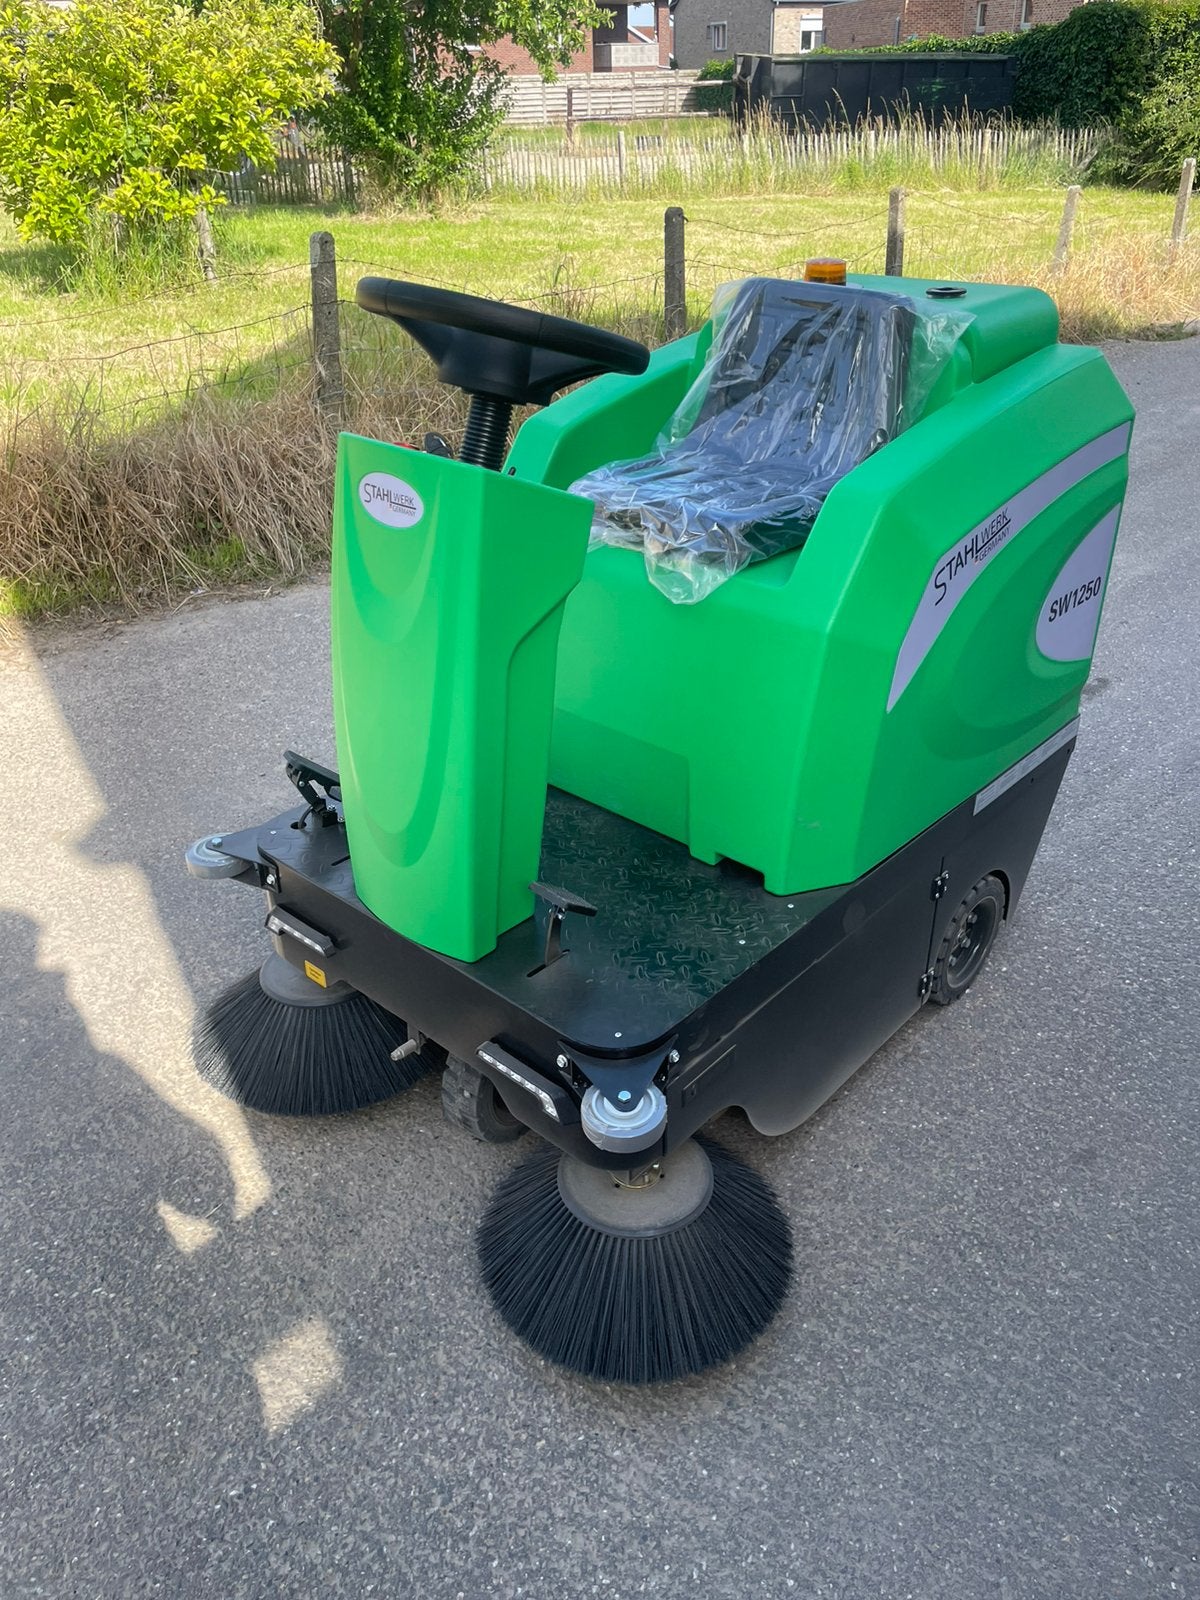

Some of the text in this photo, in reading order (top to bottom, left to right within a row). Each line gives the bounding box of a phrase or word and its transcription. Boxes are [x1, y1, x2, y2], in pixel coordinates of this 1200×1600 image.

[363, 482, 416, 508] STAHLWERK
[392, 505, 416, 517] GERMANY
[934, 507, 1010, 606] STAHLWERK
[978, 527, 1010, 562] GERMANY
[1048, 576, 1102, 622] SW1250
